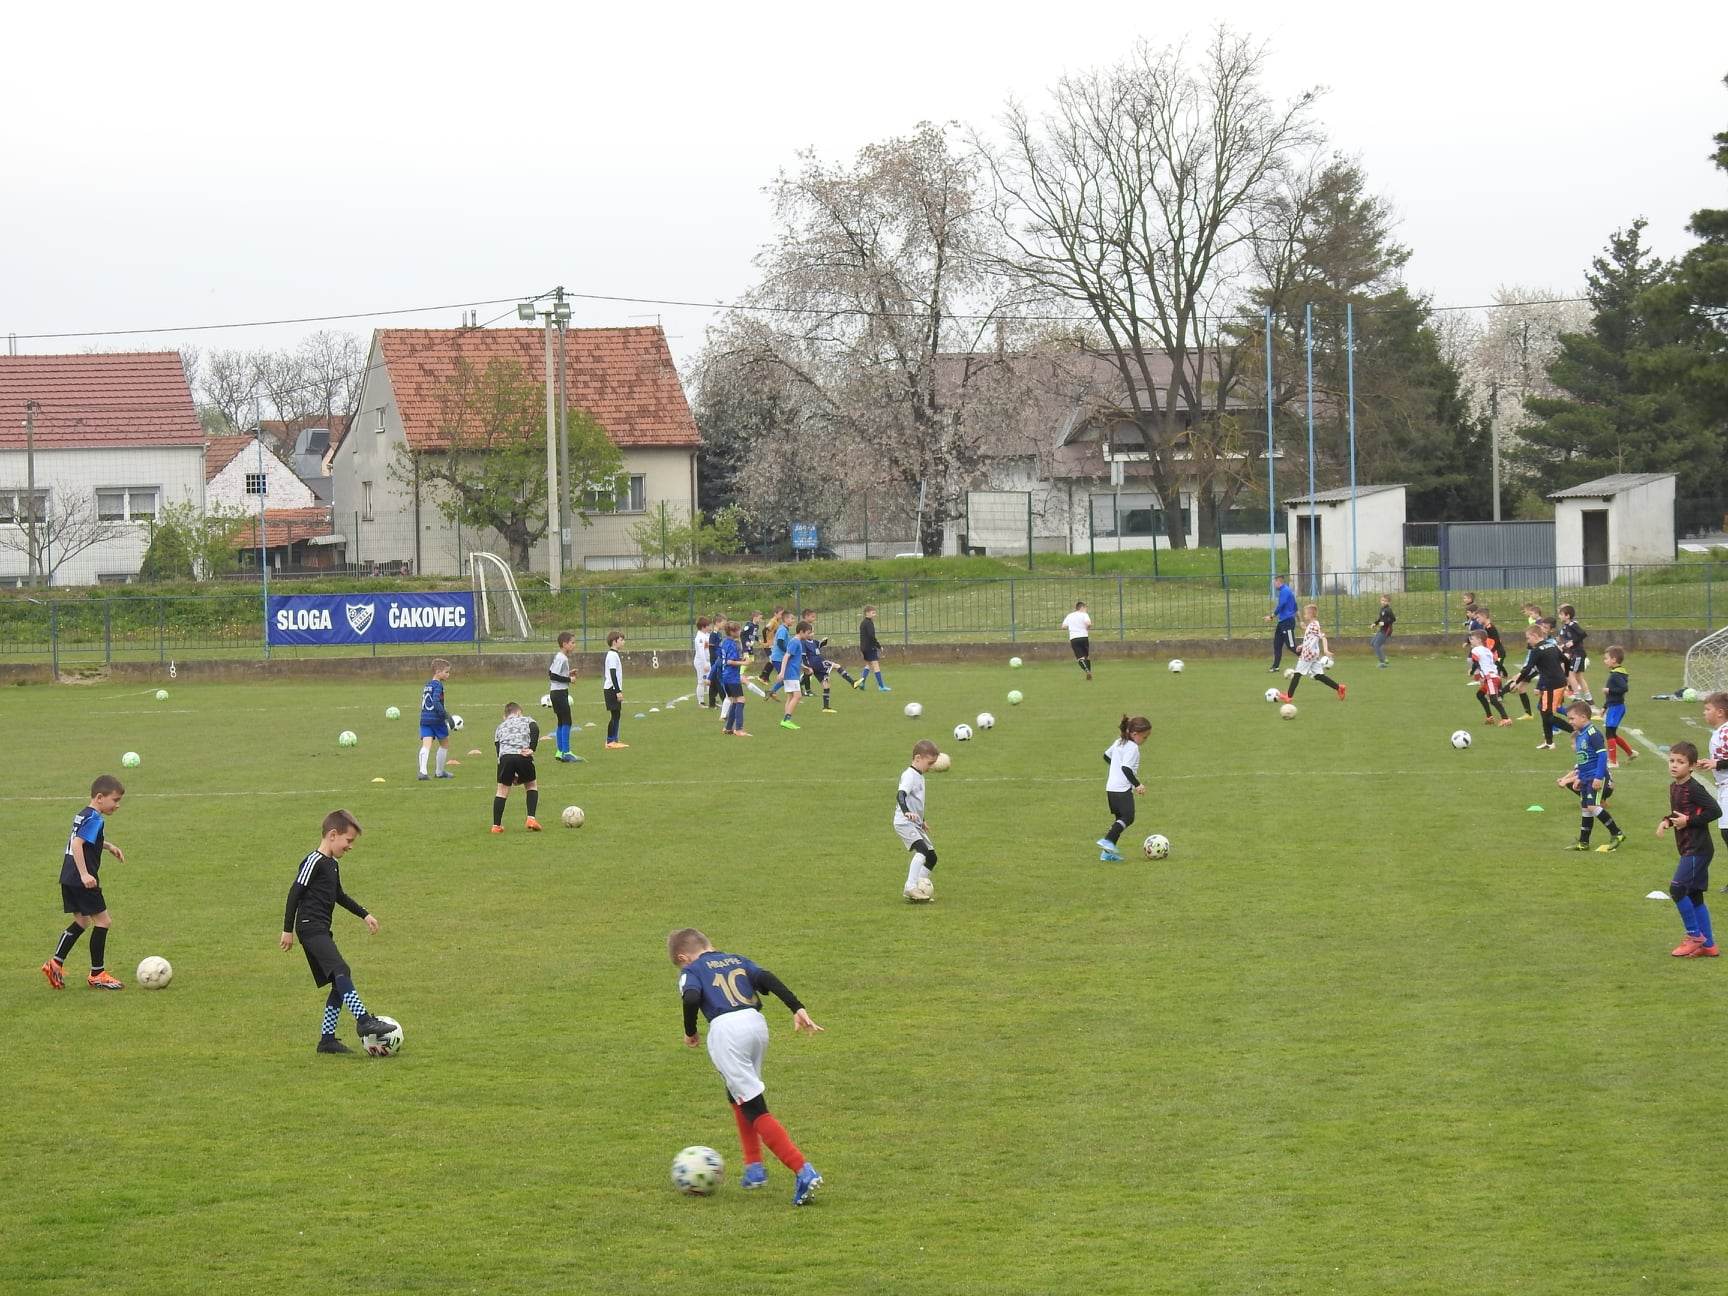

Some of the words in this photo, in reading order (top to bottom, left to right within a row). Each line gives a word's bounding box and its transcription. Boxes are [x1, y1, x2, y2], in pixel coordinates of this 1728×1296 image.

[276, 609, 332, 631] SLOGA
[388, 602, 466, 629] ČAKOVEC
[712, 968, 758, 1007] 10
